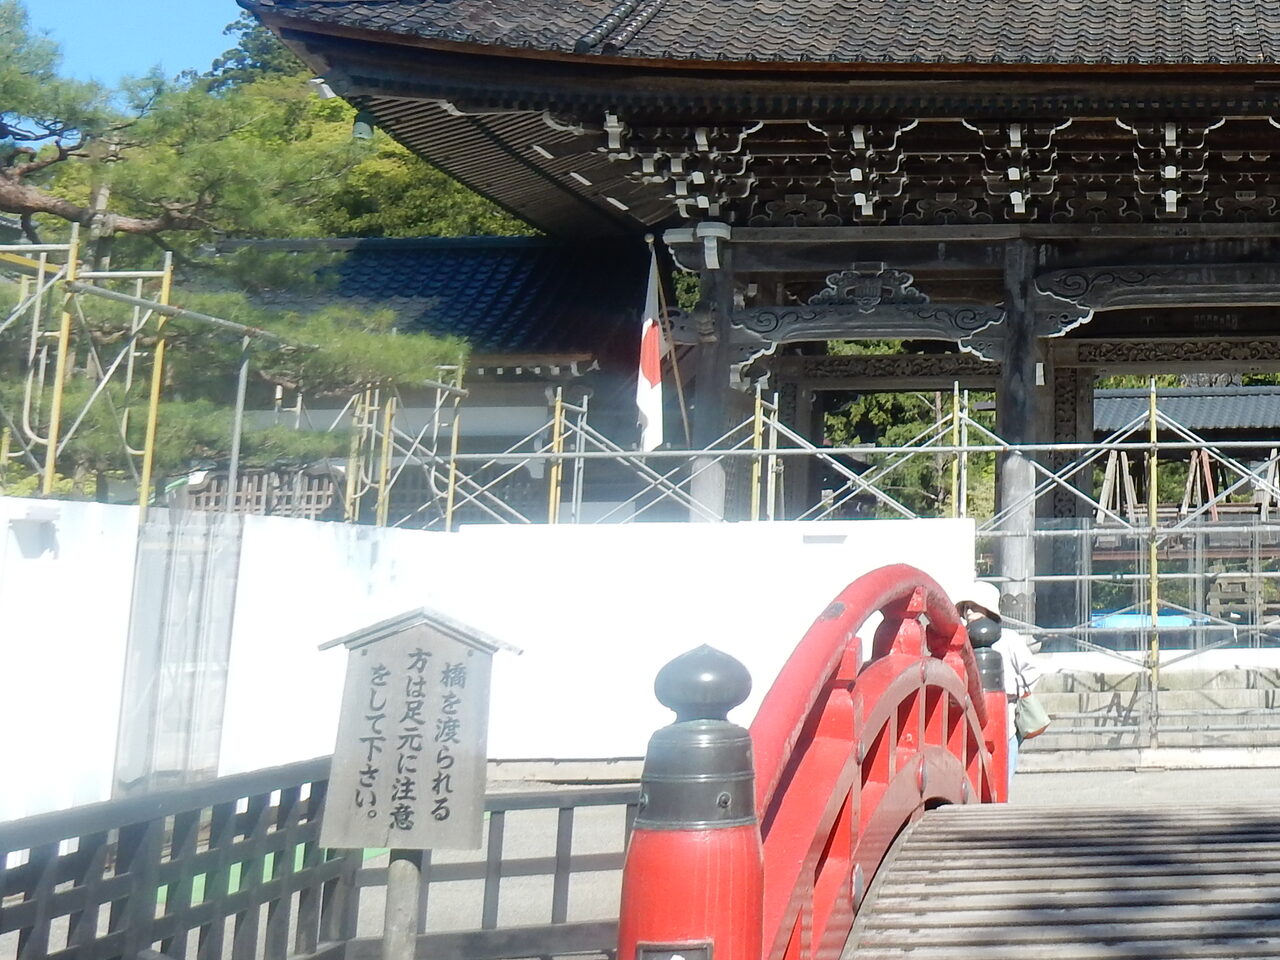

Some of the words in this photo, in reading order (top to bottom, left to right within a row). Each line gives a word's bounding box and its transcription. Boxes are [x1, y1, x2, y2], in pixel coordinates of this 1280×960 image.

[355, 663, 391, 819] をして下さい。
[389, 647, 432, 831] 方は足元に注意
[431, 662, 467, 822] 橋を渡られる
